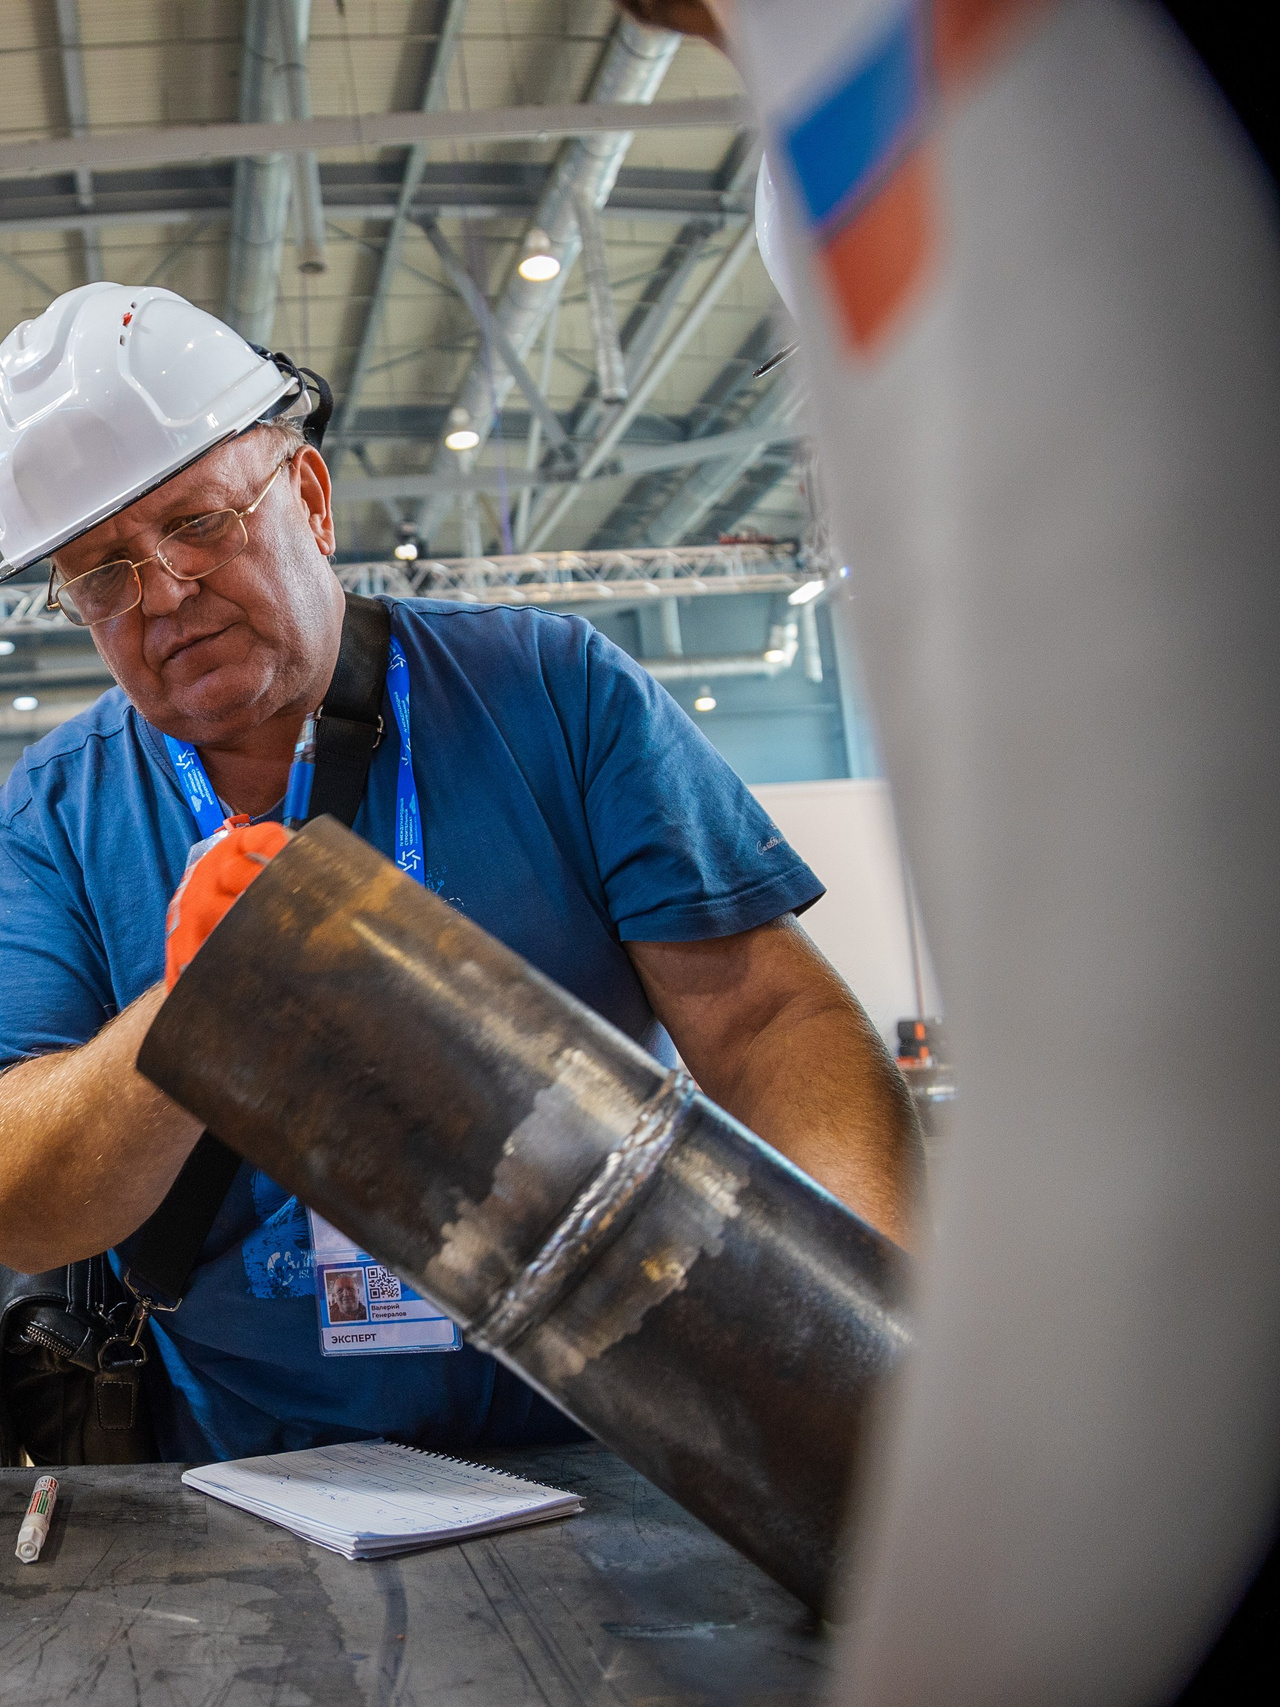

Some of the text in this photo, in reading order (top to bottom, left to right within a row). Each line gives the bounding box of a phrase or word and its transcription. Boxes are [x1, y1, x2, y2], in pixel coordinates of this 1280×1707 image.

[371, 1303, 400, 1313] Валерий
[372, 1311, 407, 1319] Генералов
[331, 1333, 377, 1345] ЭКСПЕРТ
